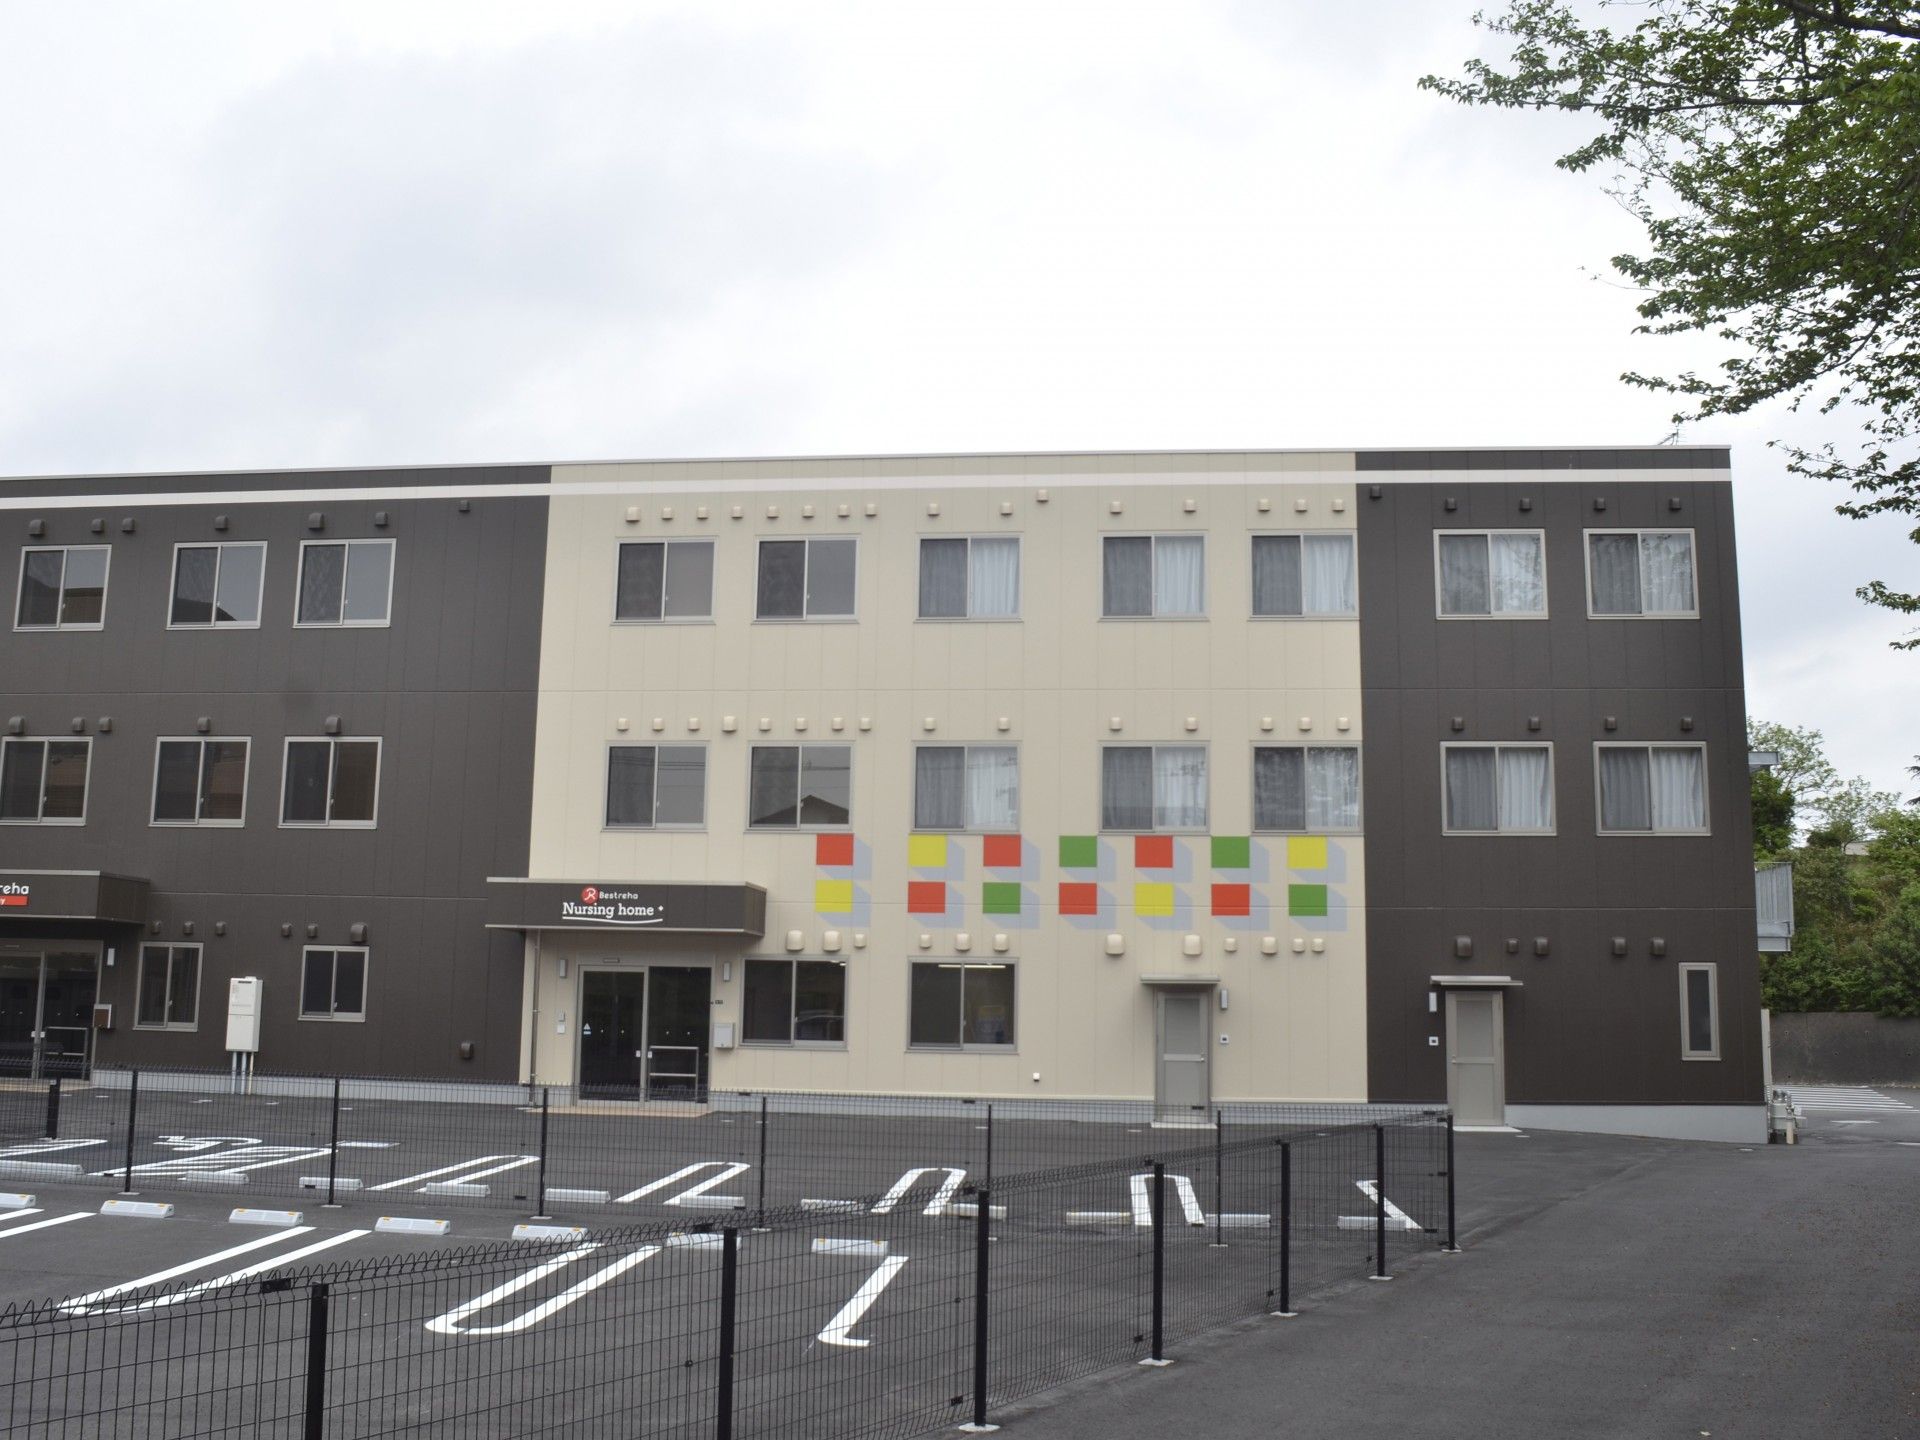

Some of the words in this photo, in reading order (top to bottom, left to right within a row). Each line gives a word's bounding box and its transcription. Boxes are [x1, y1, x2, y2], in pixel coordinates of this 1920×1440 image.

[599, 891, 639, 900] Bestreha
[562, 902, 615, 919] Nursing
[618, 903, 654, 916] home
